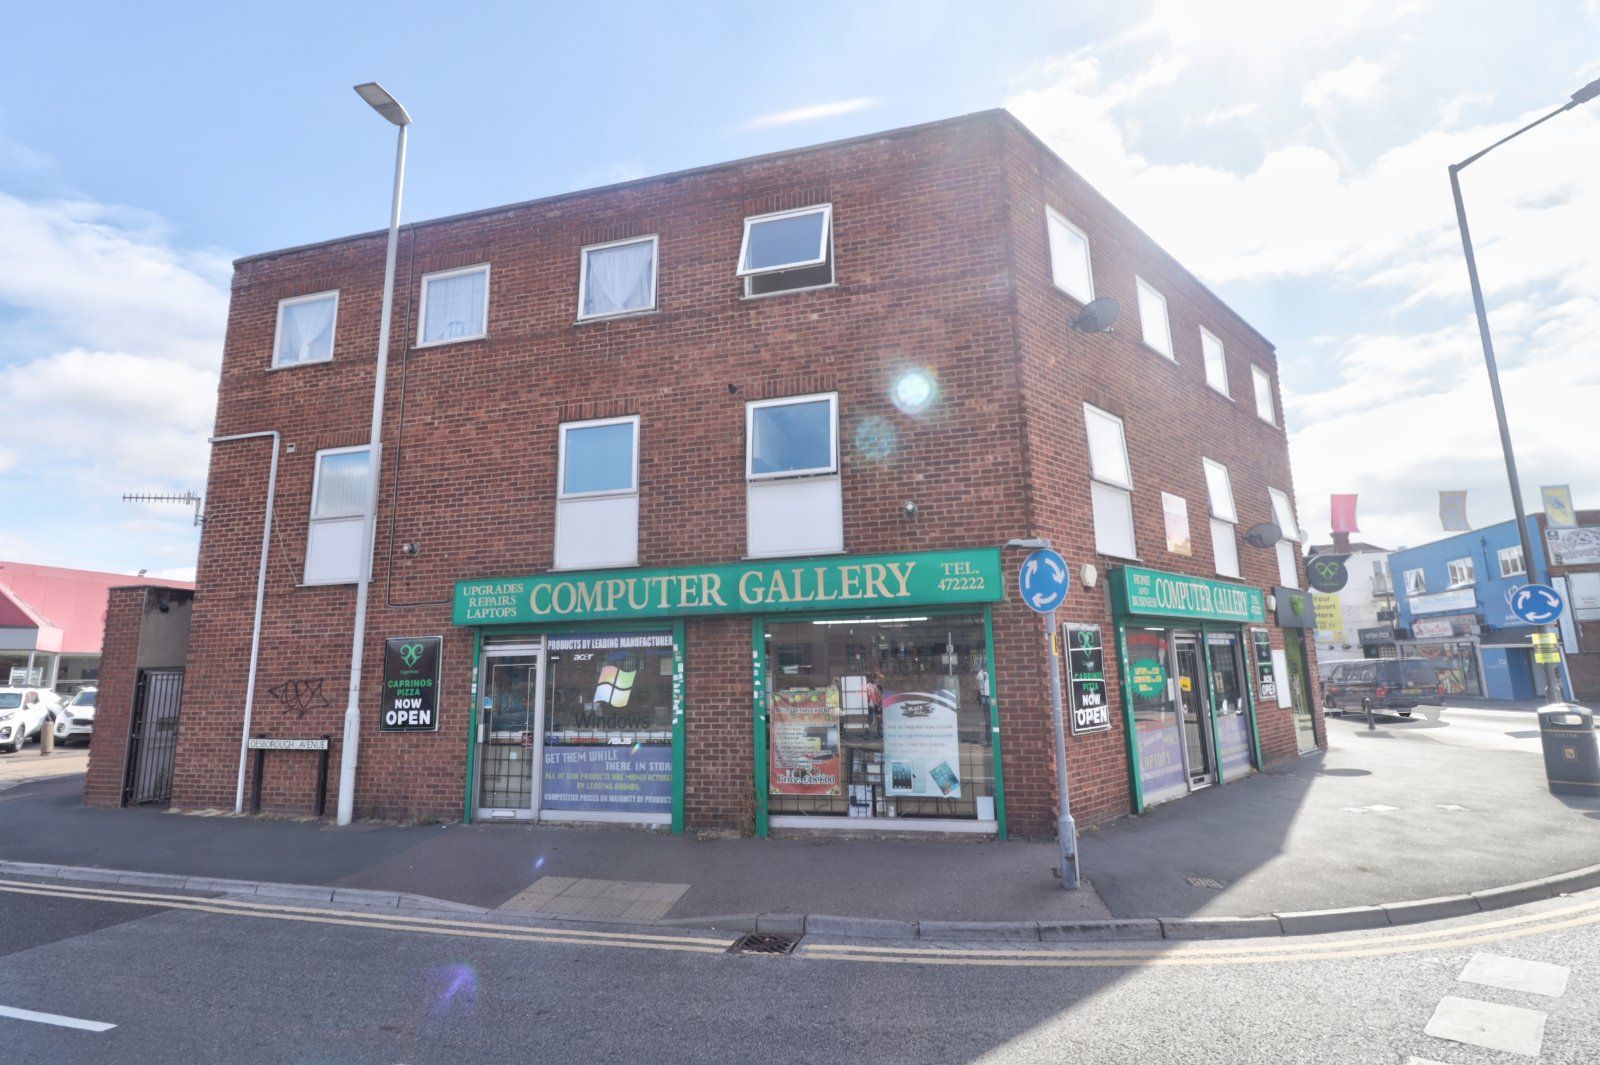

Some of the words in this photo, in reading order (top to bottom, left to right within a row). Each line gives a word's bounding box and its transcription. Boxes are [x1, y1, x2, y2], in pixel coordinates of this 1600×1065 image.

[940, 561, 980, 576] TEL.
[937, 576, 985, 591] 472222
[1133, 574, 1151, 586] HOME
[463, 583, 524, 596] UPGRADES
[529, 573, 728, 615] COMPUTER
[738, 562, 916, 605] GALLERY
[468, 595, 517, 608] REPAIRS
[1155, 578, 1214, 613] COMPUTER
[1213, 586, 1249, 616] GALLERY
[466, 606, 518, 619] LAPTOPS
[547, 640, 582, 650] PRODUCTS
[582, 639, 591, 649] BY
[592, 638, 619, 649] LEADING
[620, 636, 673, 648] MANUFACTURER
[573, 653, 594, 661] acer
[387, 679, 433, 688] CAPRINOS
[397, 688, 421, 696] PIZZA
[394, 698, 422, 709] NOW
[1082, 694, 1101, 706] NOW
[386, 710, 431, 725] OPEN
[572, 713, 650, 729] Windows
[1077, 709, 1108, 726] OPEN
[299, 741, 326, 749] AVENUE
[608, 737, 632, 745] ASUS
[545, 754, 561, 764] GET
[563, 752, 586, 763] THEM
[589, 749, 619, 761] WHILE
[605, 762, 632, 771] THERE
[635, 762, 646, 771] IN
[649, 762, 673, 772] STOR
[645, 796, 672, 804] PRODUCT
